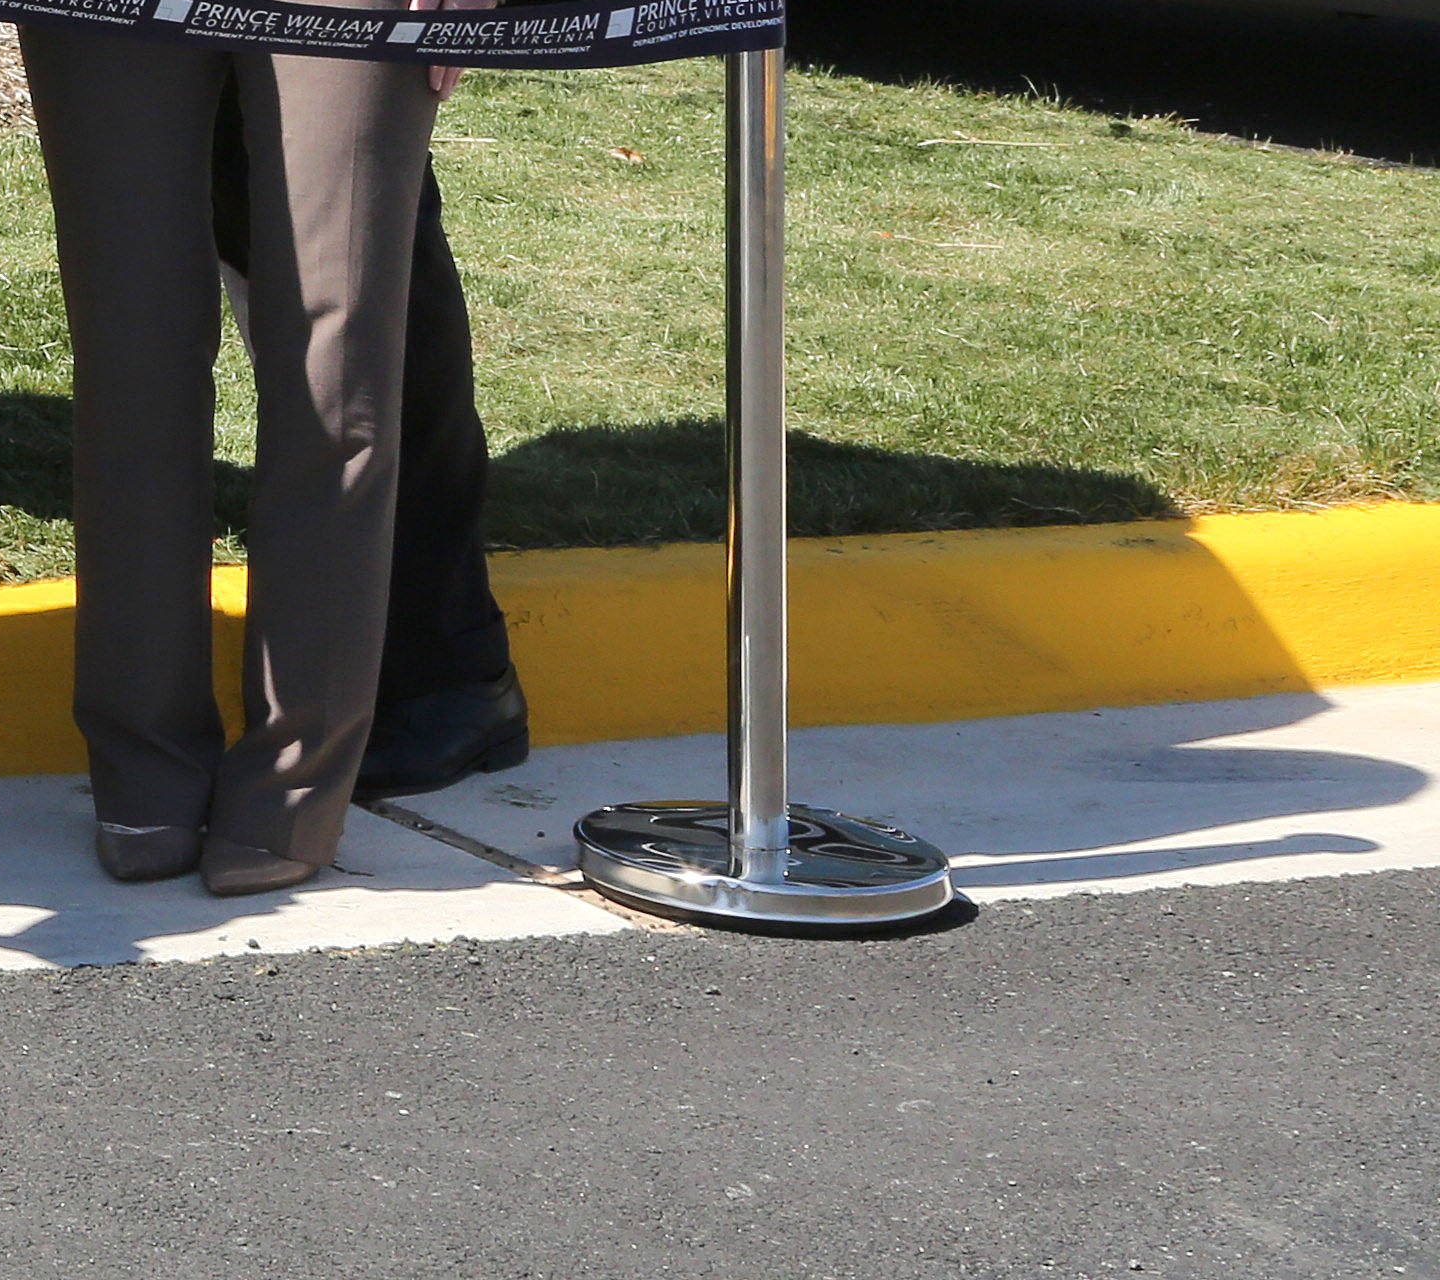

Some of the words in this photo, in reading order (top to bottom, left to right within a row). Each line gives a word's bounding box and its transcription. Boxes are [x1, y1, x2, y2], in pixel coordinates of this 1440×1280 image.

[8, 0, 22, 9] OF
[22, 2, 71, 17] ECONOMIC
[72, 10, 136, 26] DEVELOPMENT
[194, 1, 282, 27] PRINCE
[286, 14, 384, 34] WILLIAM
[427, 21, 509, 37] PRINCE
[513, 12, 600, 36] WILLIAM
[636, 13, 701, 35] COUNTY,
[704, 0, 784, 19] VIRGINIA
[185, 27, 244, 39] DEPARTMENT
[258, 35, 305, 45] ECONOMIC
[306, 39, 369, 49] DEVELOPMENT
[191, 16, 277, 35] COUNTY,
[284, 27, 375, 41] VIRGINIA
[422, 36, 505, 47] COUNTY,
[511, 31, 595, 45] VIRGINIA
[632, 31, 678, 48] DEPARTMENT
[678, 28, 689, 38] OF
[689, 23, 730, 37] ECONOMIC
[416, 46, 472, 54] DEPARTMENT
[533, 45, 592, 55] DEVELOPMENT
